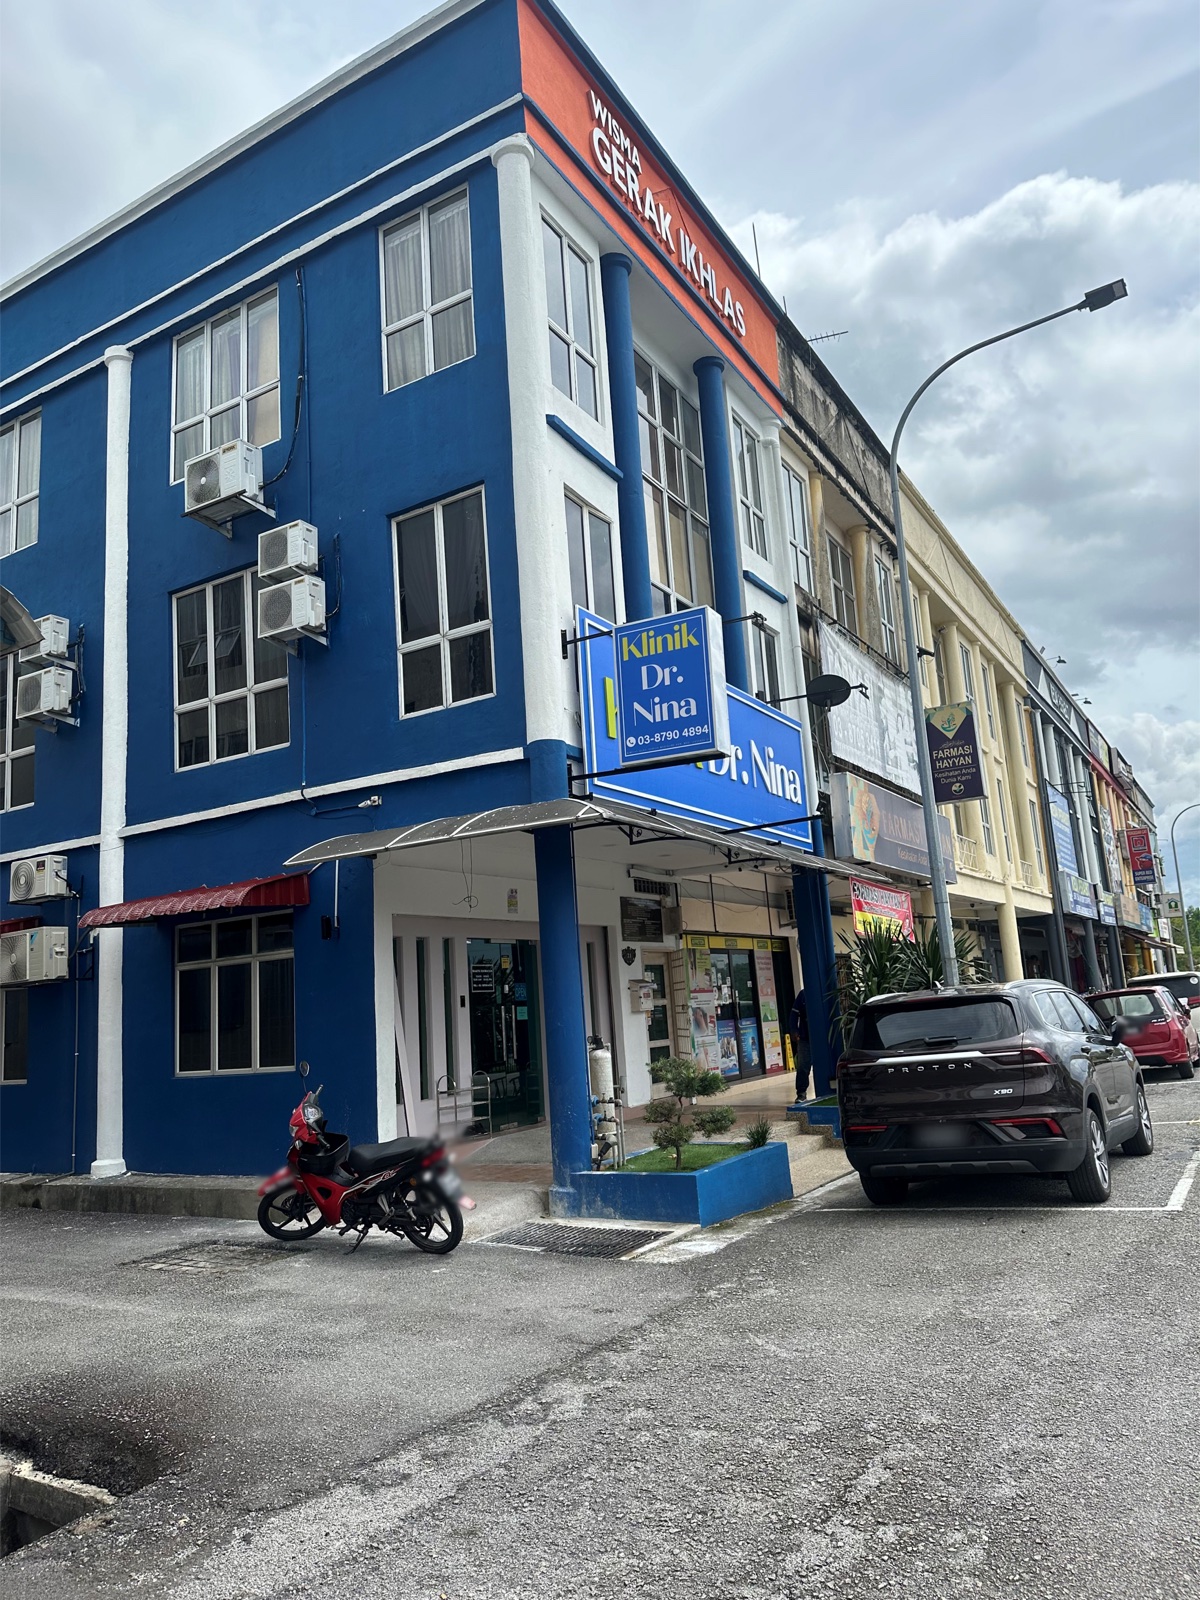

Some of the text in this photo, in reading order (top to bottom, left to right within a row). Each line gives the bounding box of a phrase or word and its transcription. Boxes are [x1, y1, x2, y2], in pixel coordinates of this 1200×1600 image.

[589, 89, 642, 174] WISMA
[591, 127, 746, 337] GERAK IKHLAS
[622, 622, 700, 661] Klinik
[641, 663, 684, 691] Dr.
[633, 696, 697, 727] Nina
[637, 724, 709, 745] 03-8790 4894
[932, 744, 973, 759] FARMASI
[935, 755, 972, 769] HAYYAN
[750, 739, 802, 805] Nina
[934, 769, 961, 778] Kesihatan
[940, 775, 957, 784] Dunia
[881, 809, 923, 845] FARMASI
[888, 1062, 972, 1074] PROTON
